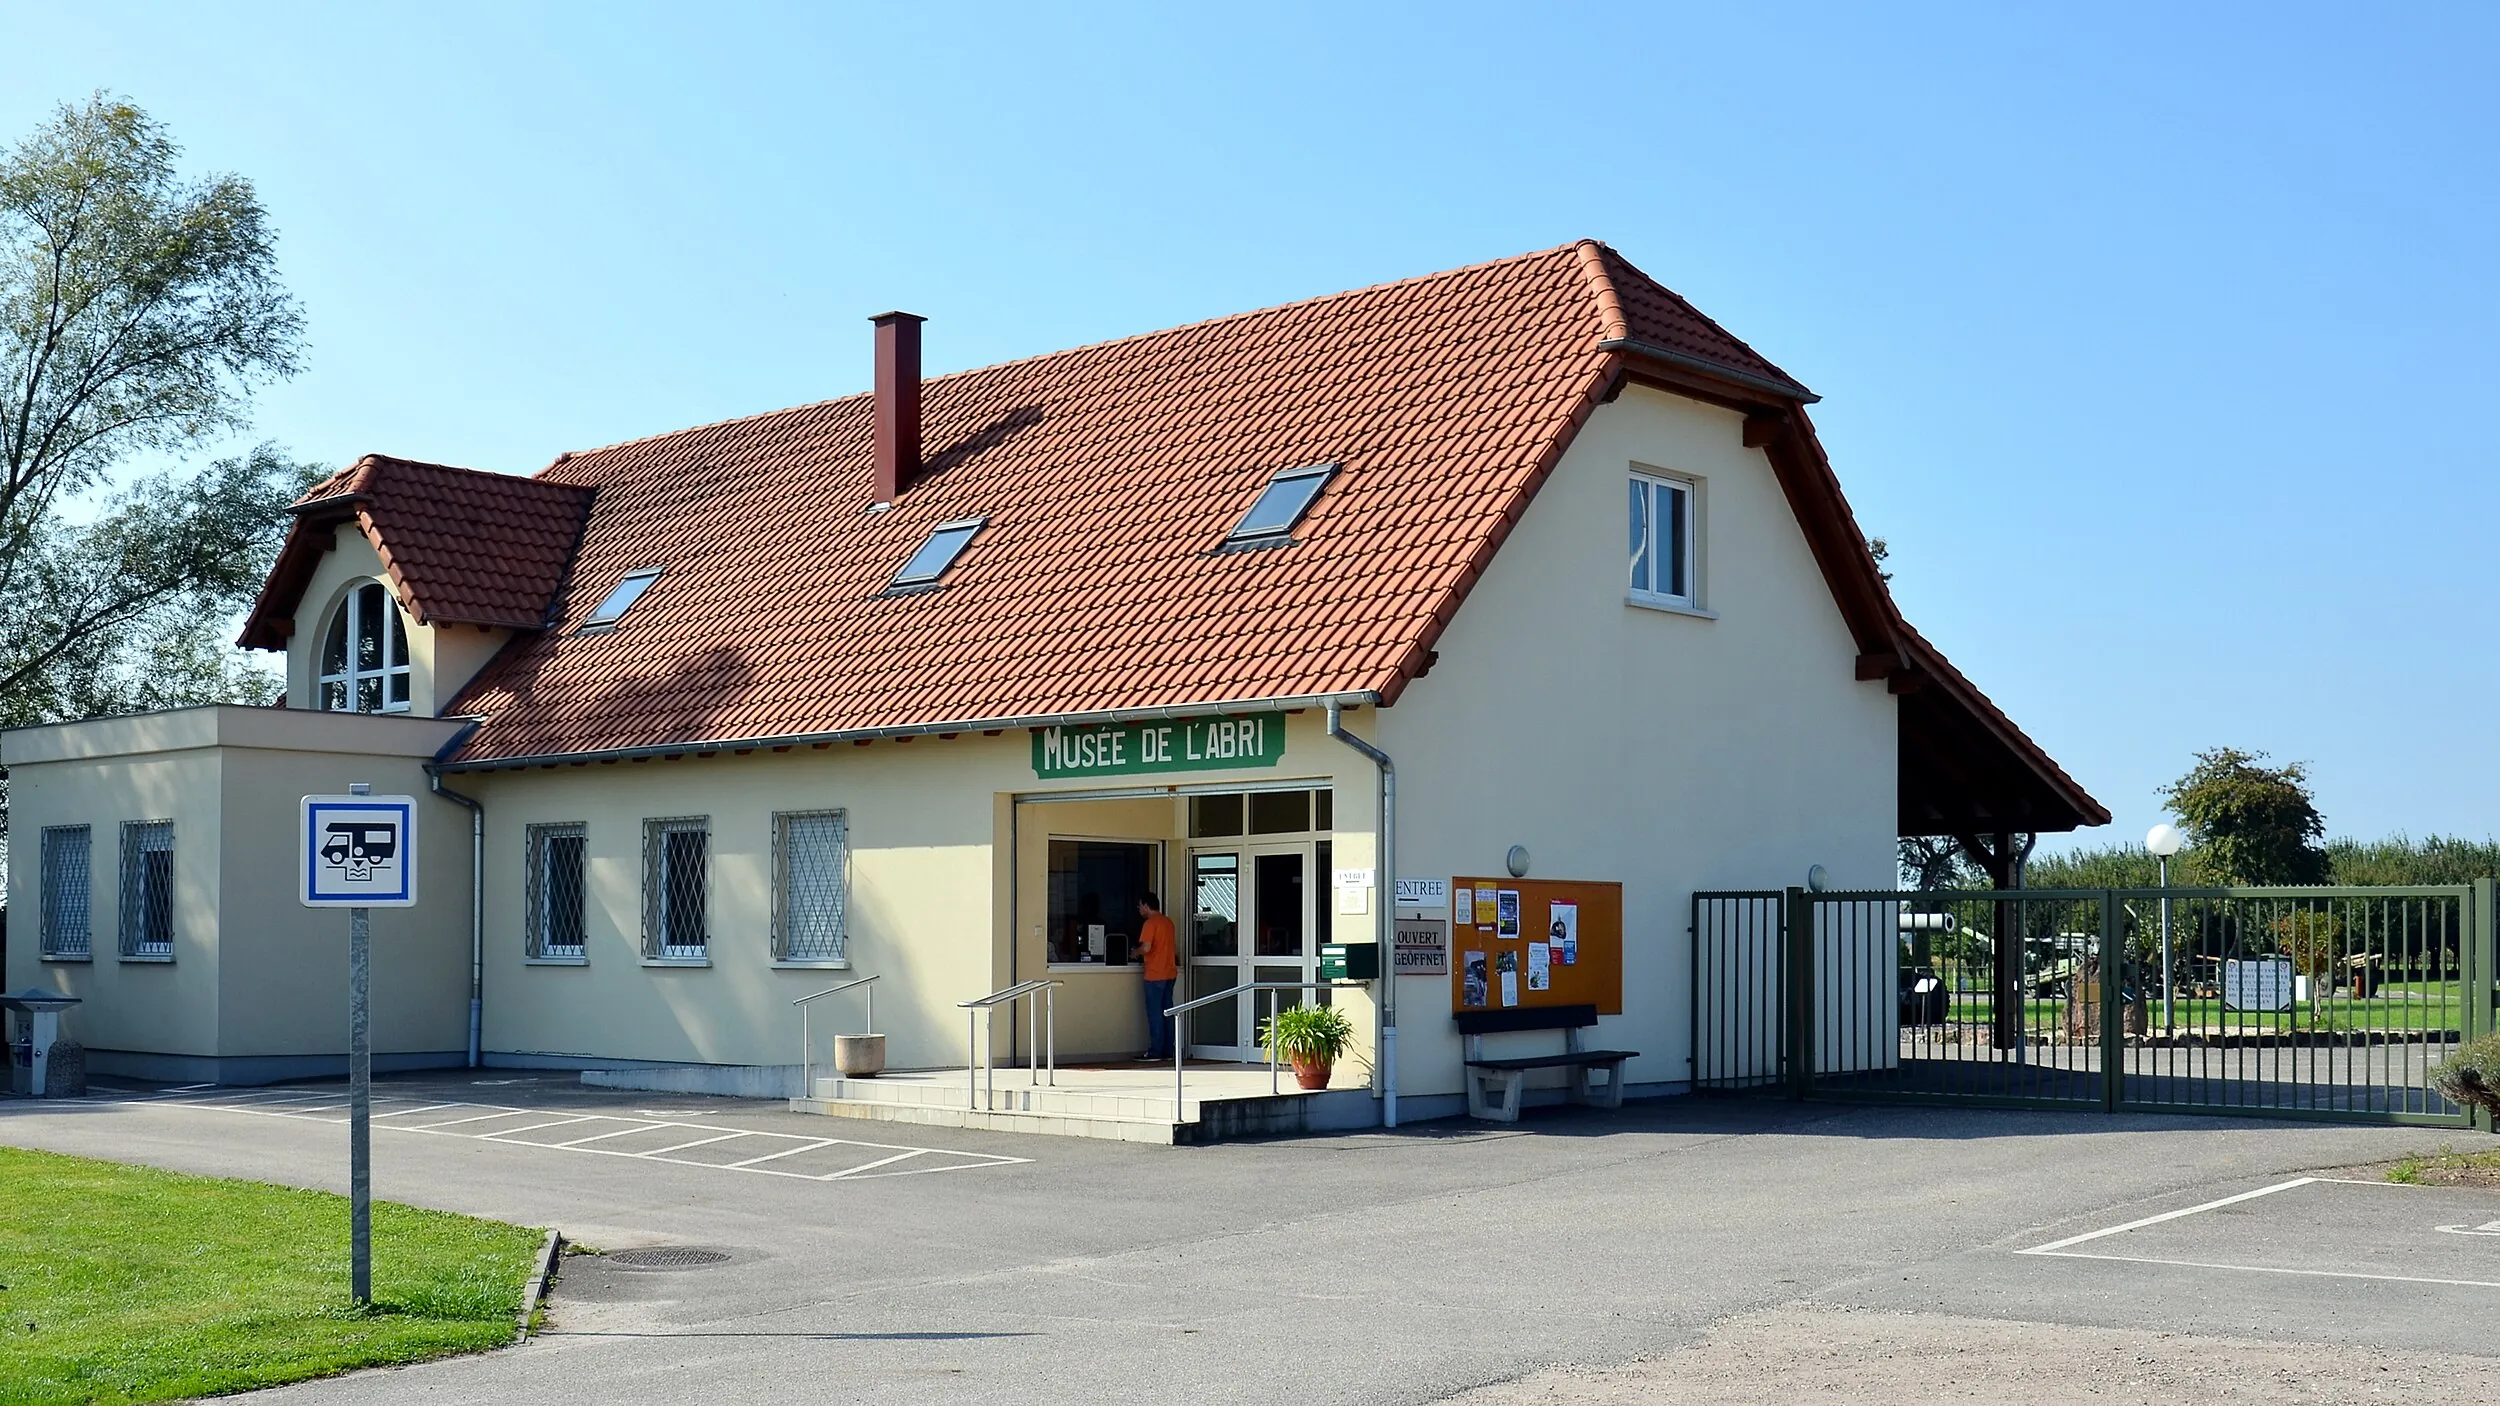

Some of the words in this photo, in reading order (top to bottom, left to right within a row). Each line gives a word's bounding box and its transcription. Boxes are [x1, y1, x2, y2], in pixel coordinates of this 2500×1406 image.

[1044, 726, 1127, 770] MUSÉE
[1142, 727, 1172, 762] DE
[1186, 719, 1264, 761] L'ABRI
[1396, 880, 1443, 896] ENTREE
[1397, 930, 1438, 945] OUVERT
